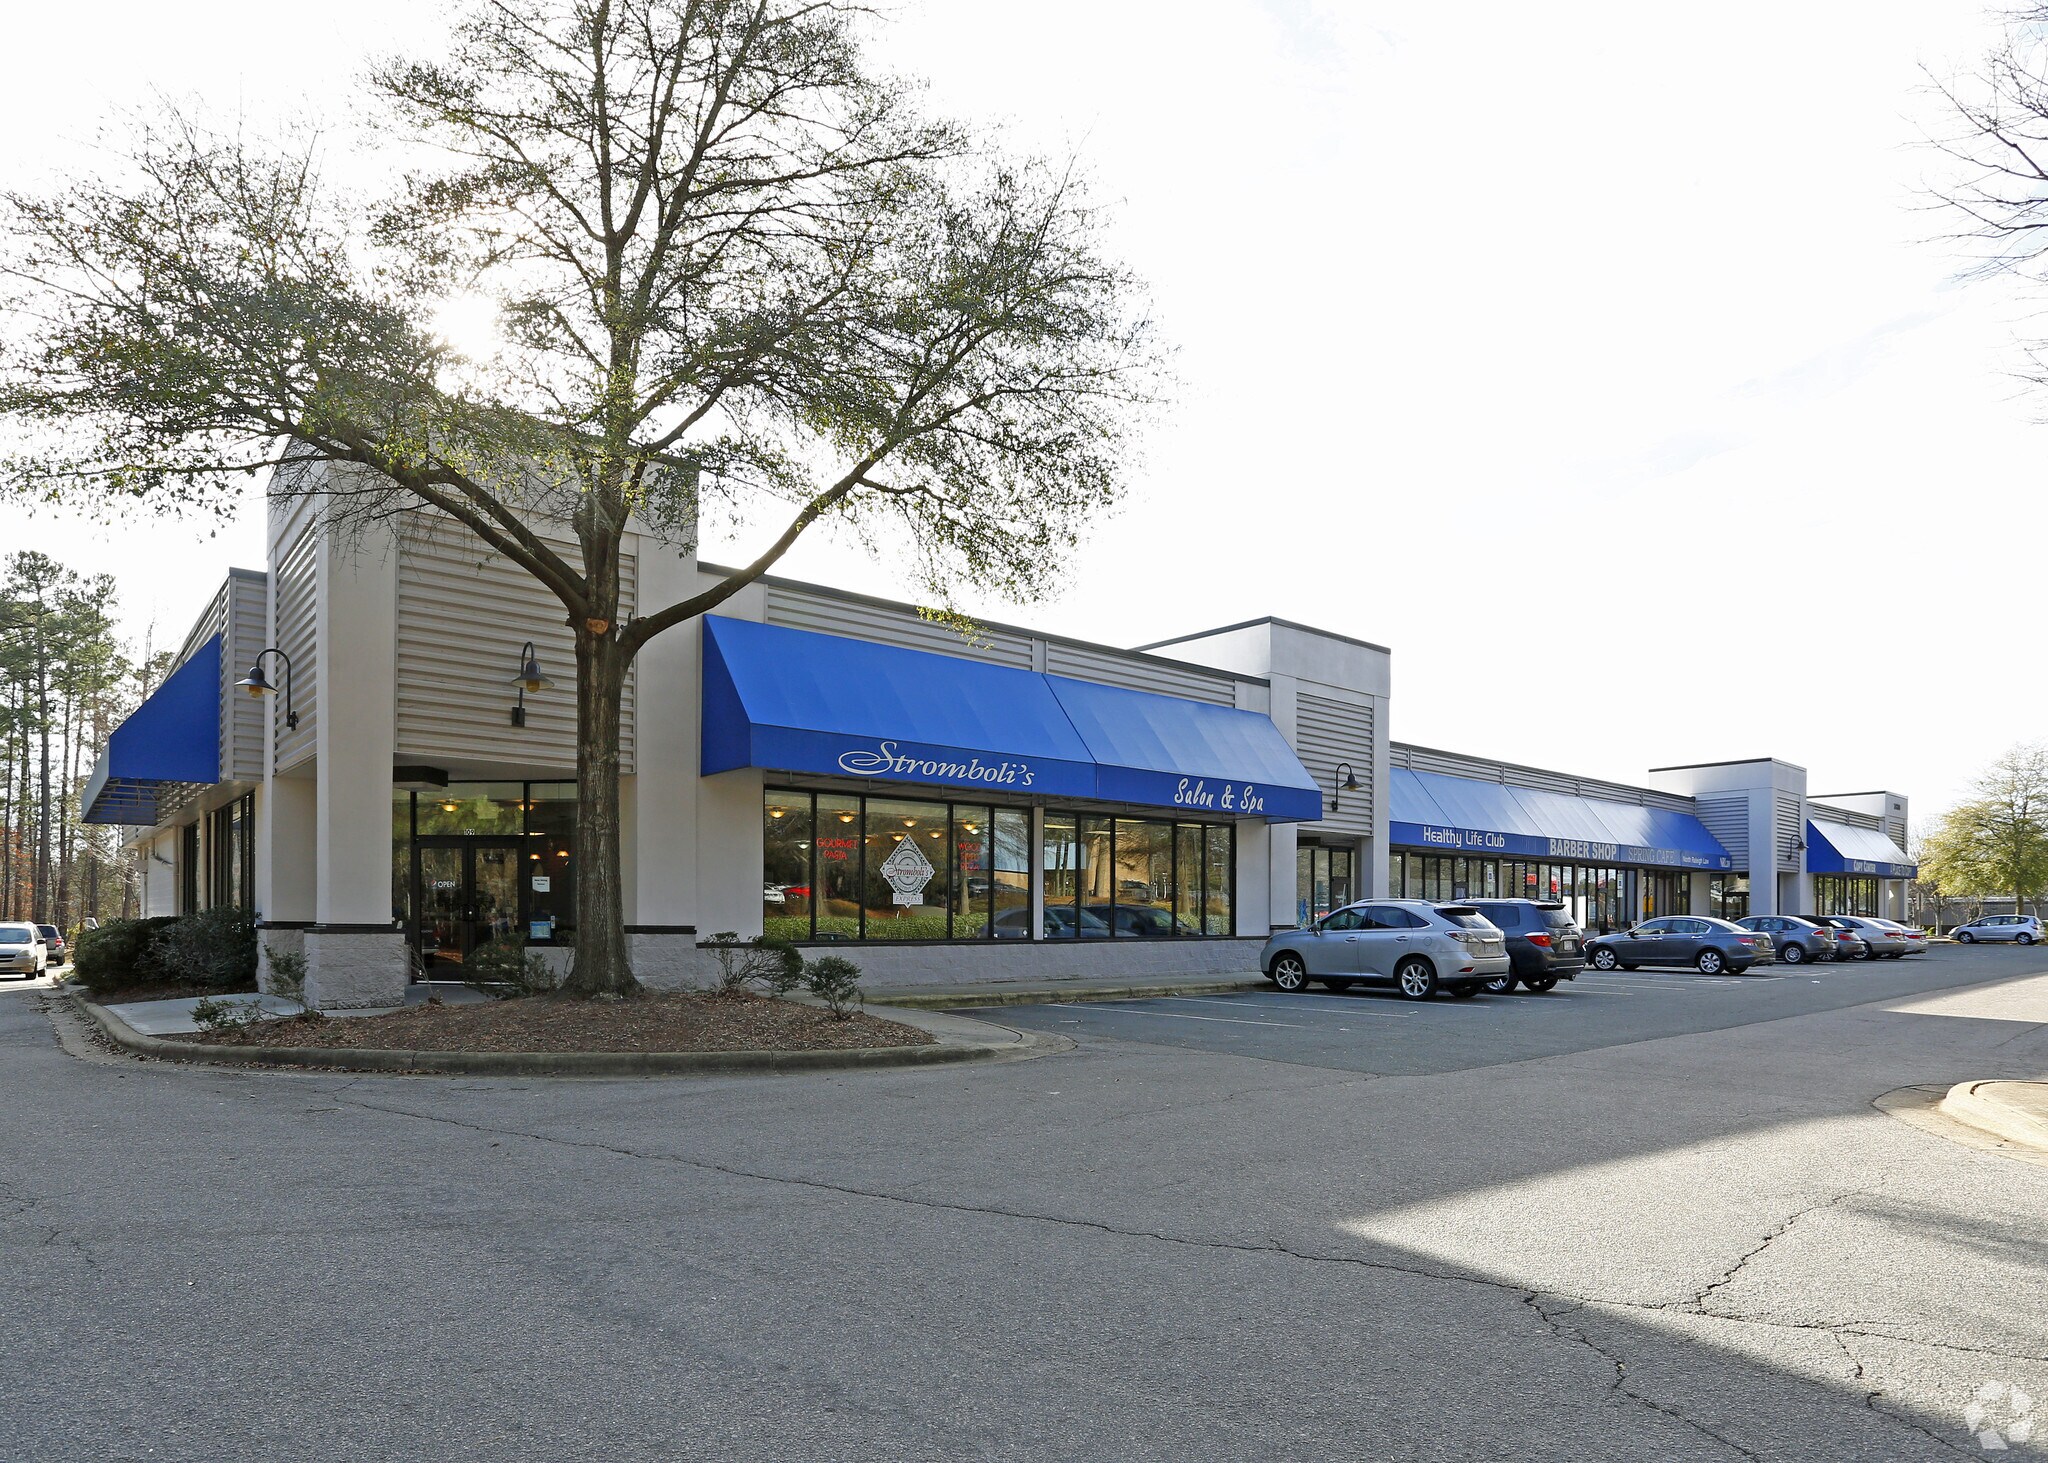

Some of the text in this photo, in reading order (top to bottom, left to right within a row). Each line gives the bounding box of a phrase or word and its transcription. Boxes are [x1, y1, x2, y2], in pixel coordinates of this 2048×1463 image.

[838, 741, 1035, 786] Stromboli's
[1174, 777, 1264, 814] Salon & Spa
[816, 837, 858, 850] GOURMET
[1423, 826, 1505, 848] Healthy Life Club
[823, 849, 848, 861] PASTA
[1549, 839, 1617, 860] BARBER SHOP
[1627, 847, 1655, 862] SPRING
